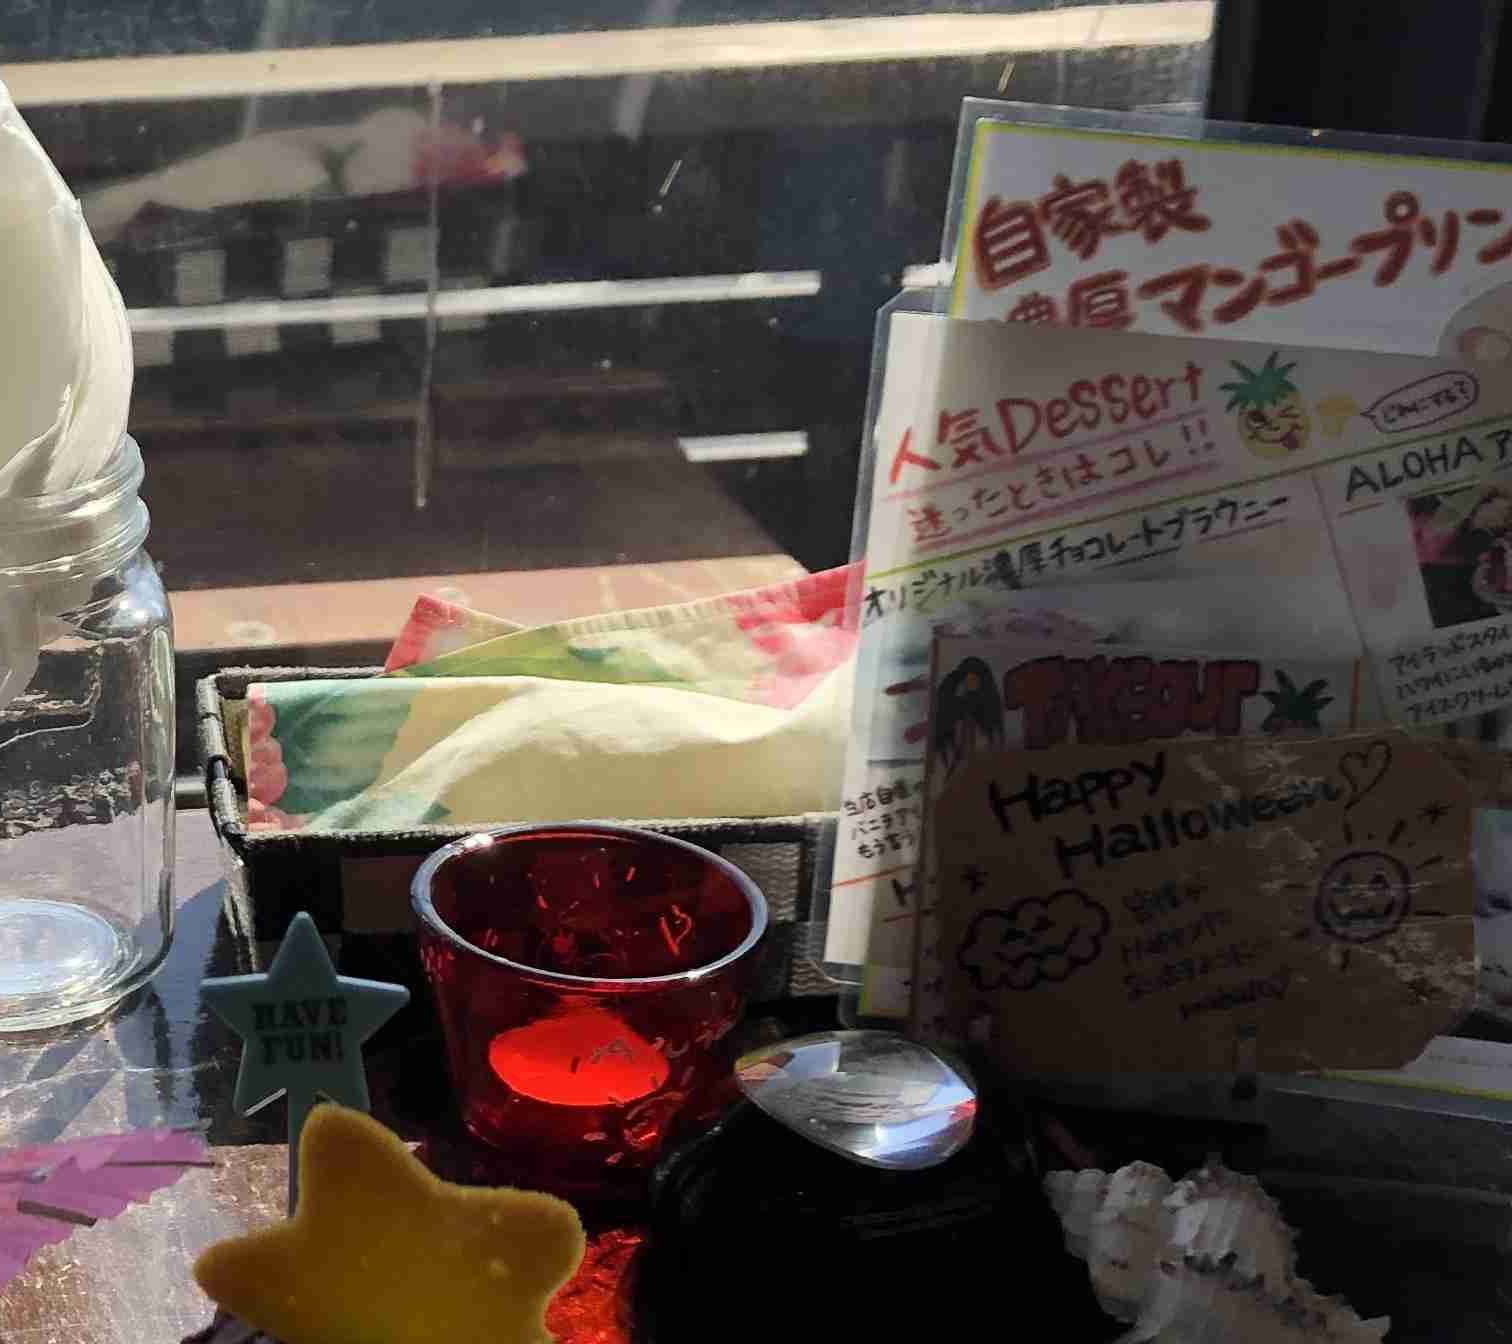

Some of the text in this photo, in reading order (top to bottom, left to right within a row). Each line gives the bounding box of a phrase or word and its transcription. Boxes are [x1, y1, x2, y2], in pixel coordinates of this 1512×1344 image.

[975, 158, 1211, 291] 自家製
[1346, 435, 1484, 502] ALOHA
[987, 750, 1168, 831] Happy
[1050, 777, 1345, 881] Halloween
[250, 997, 347, 1030] HAVE
